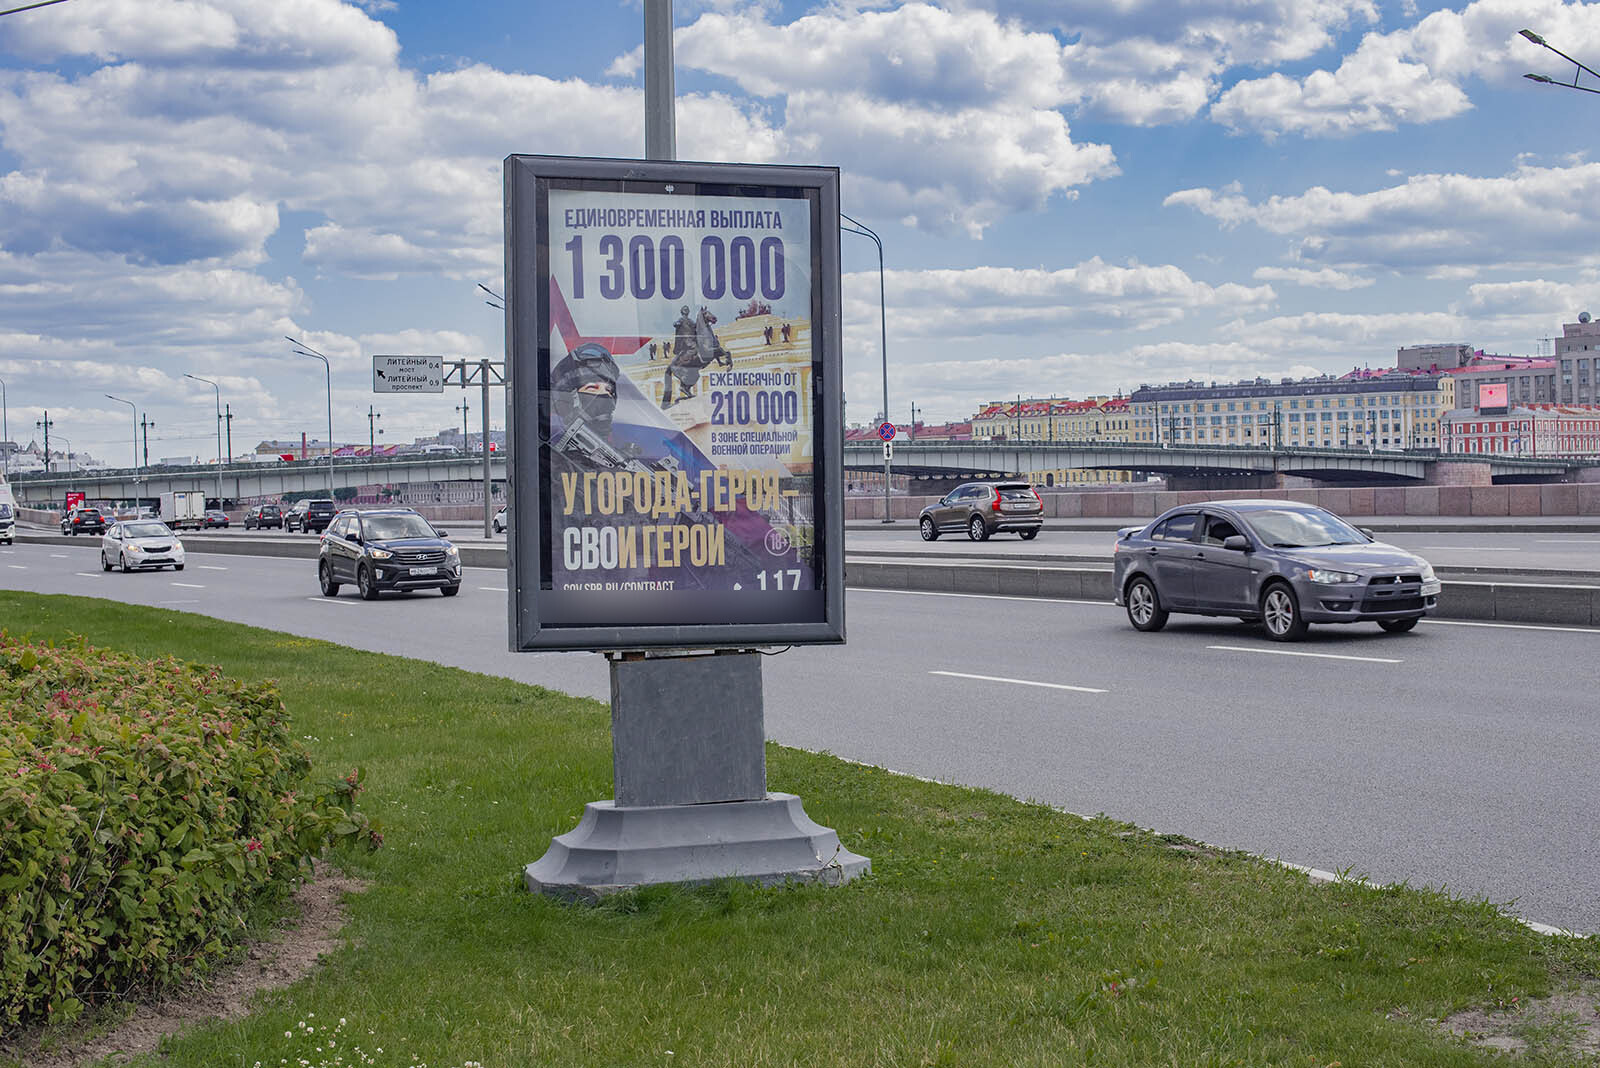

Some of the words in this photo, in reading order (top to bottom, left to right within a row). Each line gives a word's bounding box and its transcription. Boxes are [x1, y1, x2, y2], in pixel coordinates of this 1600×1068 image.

[565, 208, 705, 229] ЕДИНОВРЕМЕННАЯ
[711, 210, 782, 229] ВЫПЛАТА
[701, 235, 785, 300] 000
[387, 357, 428, 365] ЛИТЕЙНЫЙ
[387, 374, 428, 382] ЛИТЕЙНЫЙ
[709, 372, 782, 386] ЕЖЕМЕСЯЧНО
[784, 372, 797, 386] ОТ
[711, 390, 750, 425] 210
[756, 390, 797, 425] 000
[711, 432, 717, 442] В
[718, 432, 738, 442] ЗОНЕ
[740, 430, 798, 443] СПЕЦИАЛЬНОЙ
[711, 443, 748, 456] ВОЕННОЙ
[750, 444, 791, 455] ОПЕРАЦИИ
[561, 472, 577, 515] У
[563, 526, 637, 570] СВОИ
[642, 523, 726, 569] ГЕРОИ
